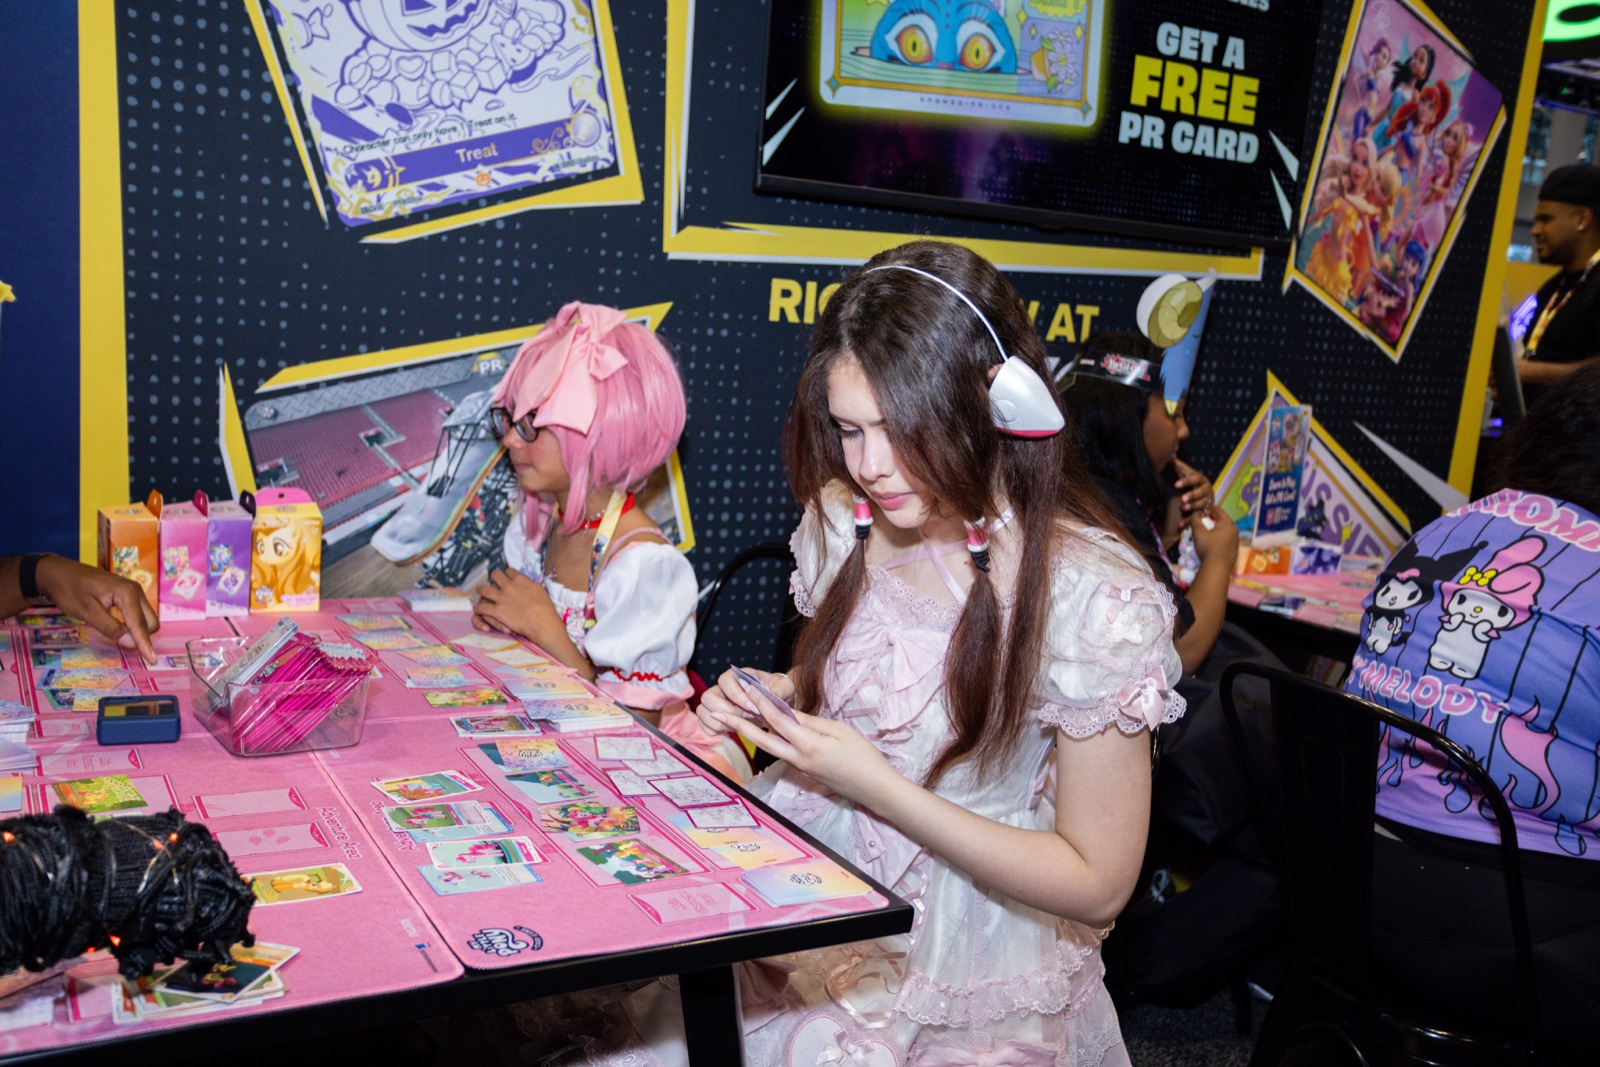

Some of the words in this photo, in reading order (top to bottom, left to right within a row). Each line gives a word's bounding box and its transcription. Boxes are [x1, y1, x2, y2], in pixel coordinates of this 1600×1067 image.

[1155, 21, 1218, 62] GET
[1221, 37, 1246, 70] A
[1129, 54, 1260, 126] FREE
[343, 134, 392, 154] Character
[393, 132, 416, 145] can
[416, 129, 434, 144] only
[434, 123, 458, 138] have
[467, 115, 495, 131] Treat
[495, 115, 508, 126] on
[454, 142, 499, 164] Treat
[1117, 111, 1164, 150] PR
[1170, 120, 1260, 164] CARD
[1045, 303, 1100, 344] AT
[478, 358, 504, 376] PR
[1358, 659, 1511, 724] MELODY
[316, 806, 351, 844] Adventure
[338, 841, 362, 860] Area
[472, 933, 497, 954] LITTLE
[479, 927, 530, 957] PONY
